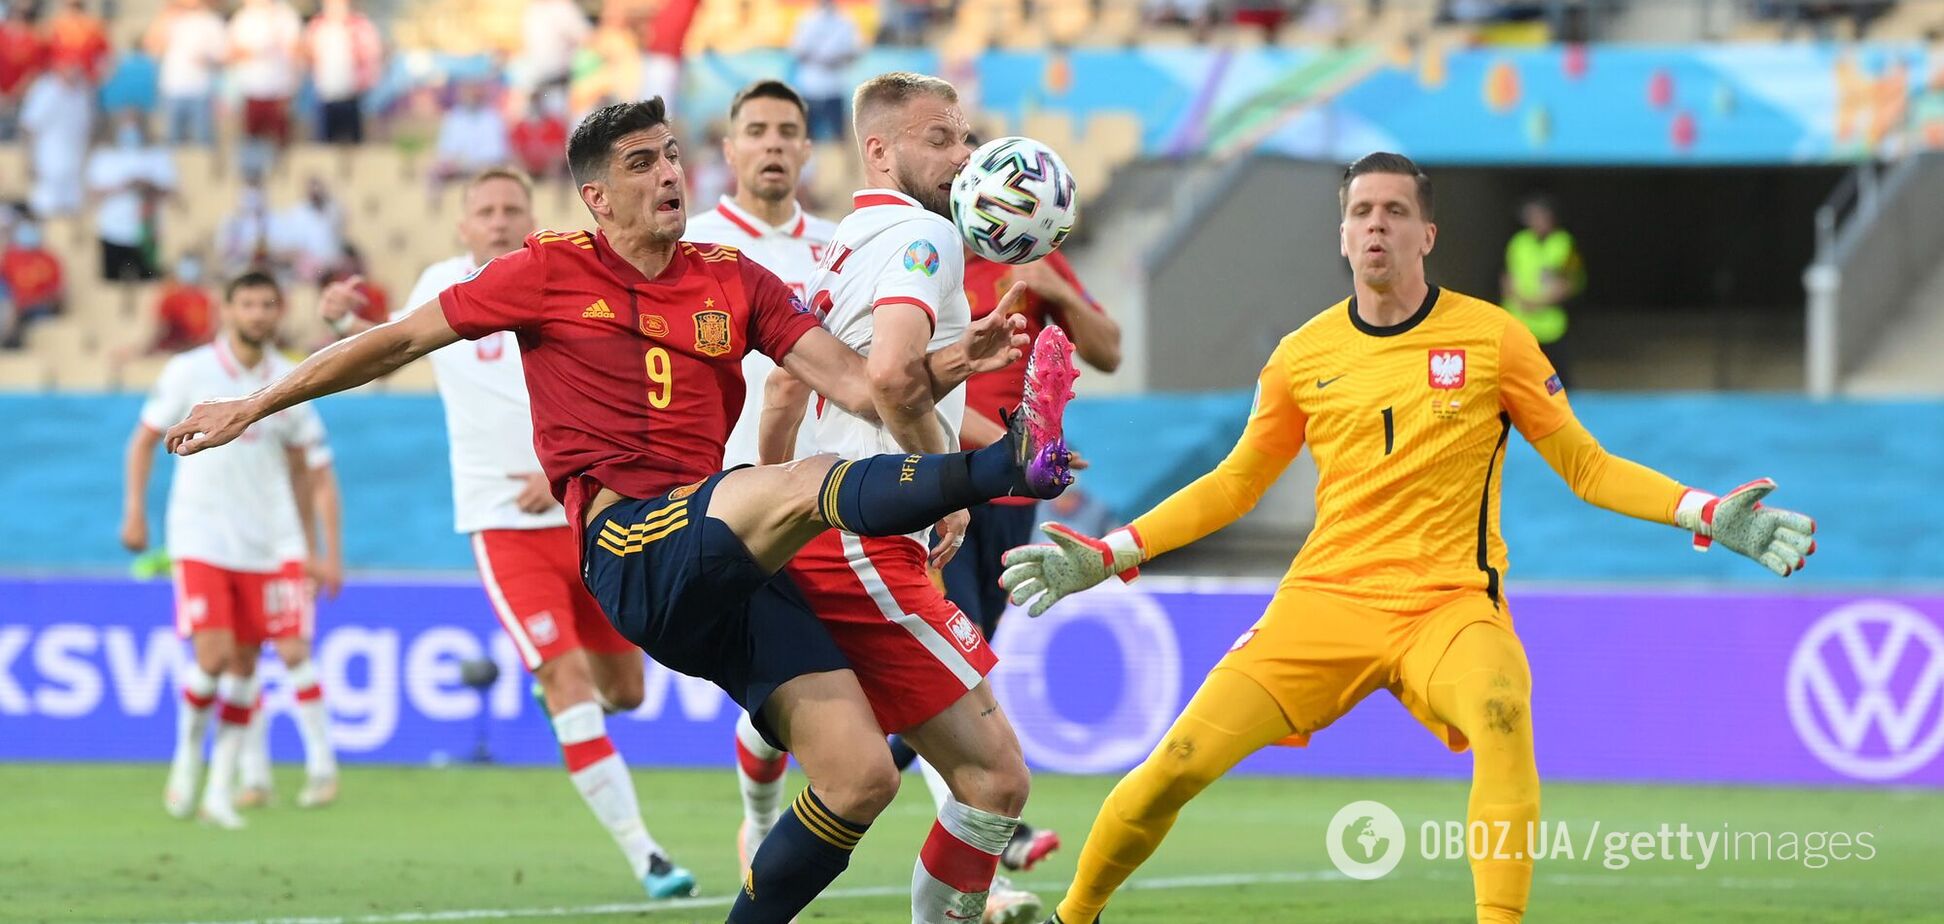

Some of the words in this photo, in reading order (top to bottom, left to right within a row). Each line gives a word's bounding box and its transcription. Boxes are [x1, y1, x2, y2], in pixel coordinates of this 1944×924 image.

[582, 311, 615, 319] adidas
[645, 347, 672, 409] 9
[1381, 405, 1394, 456] 1
